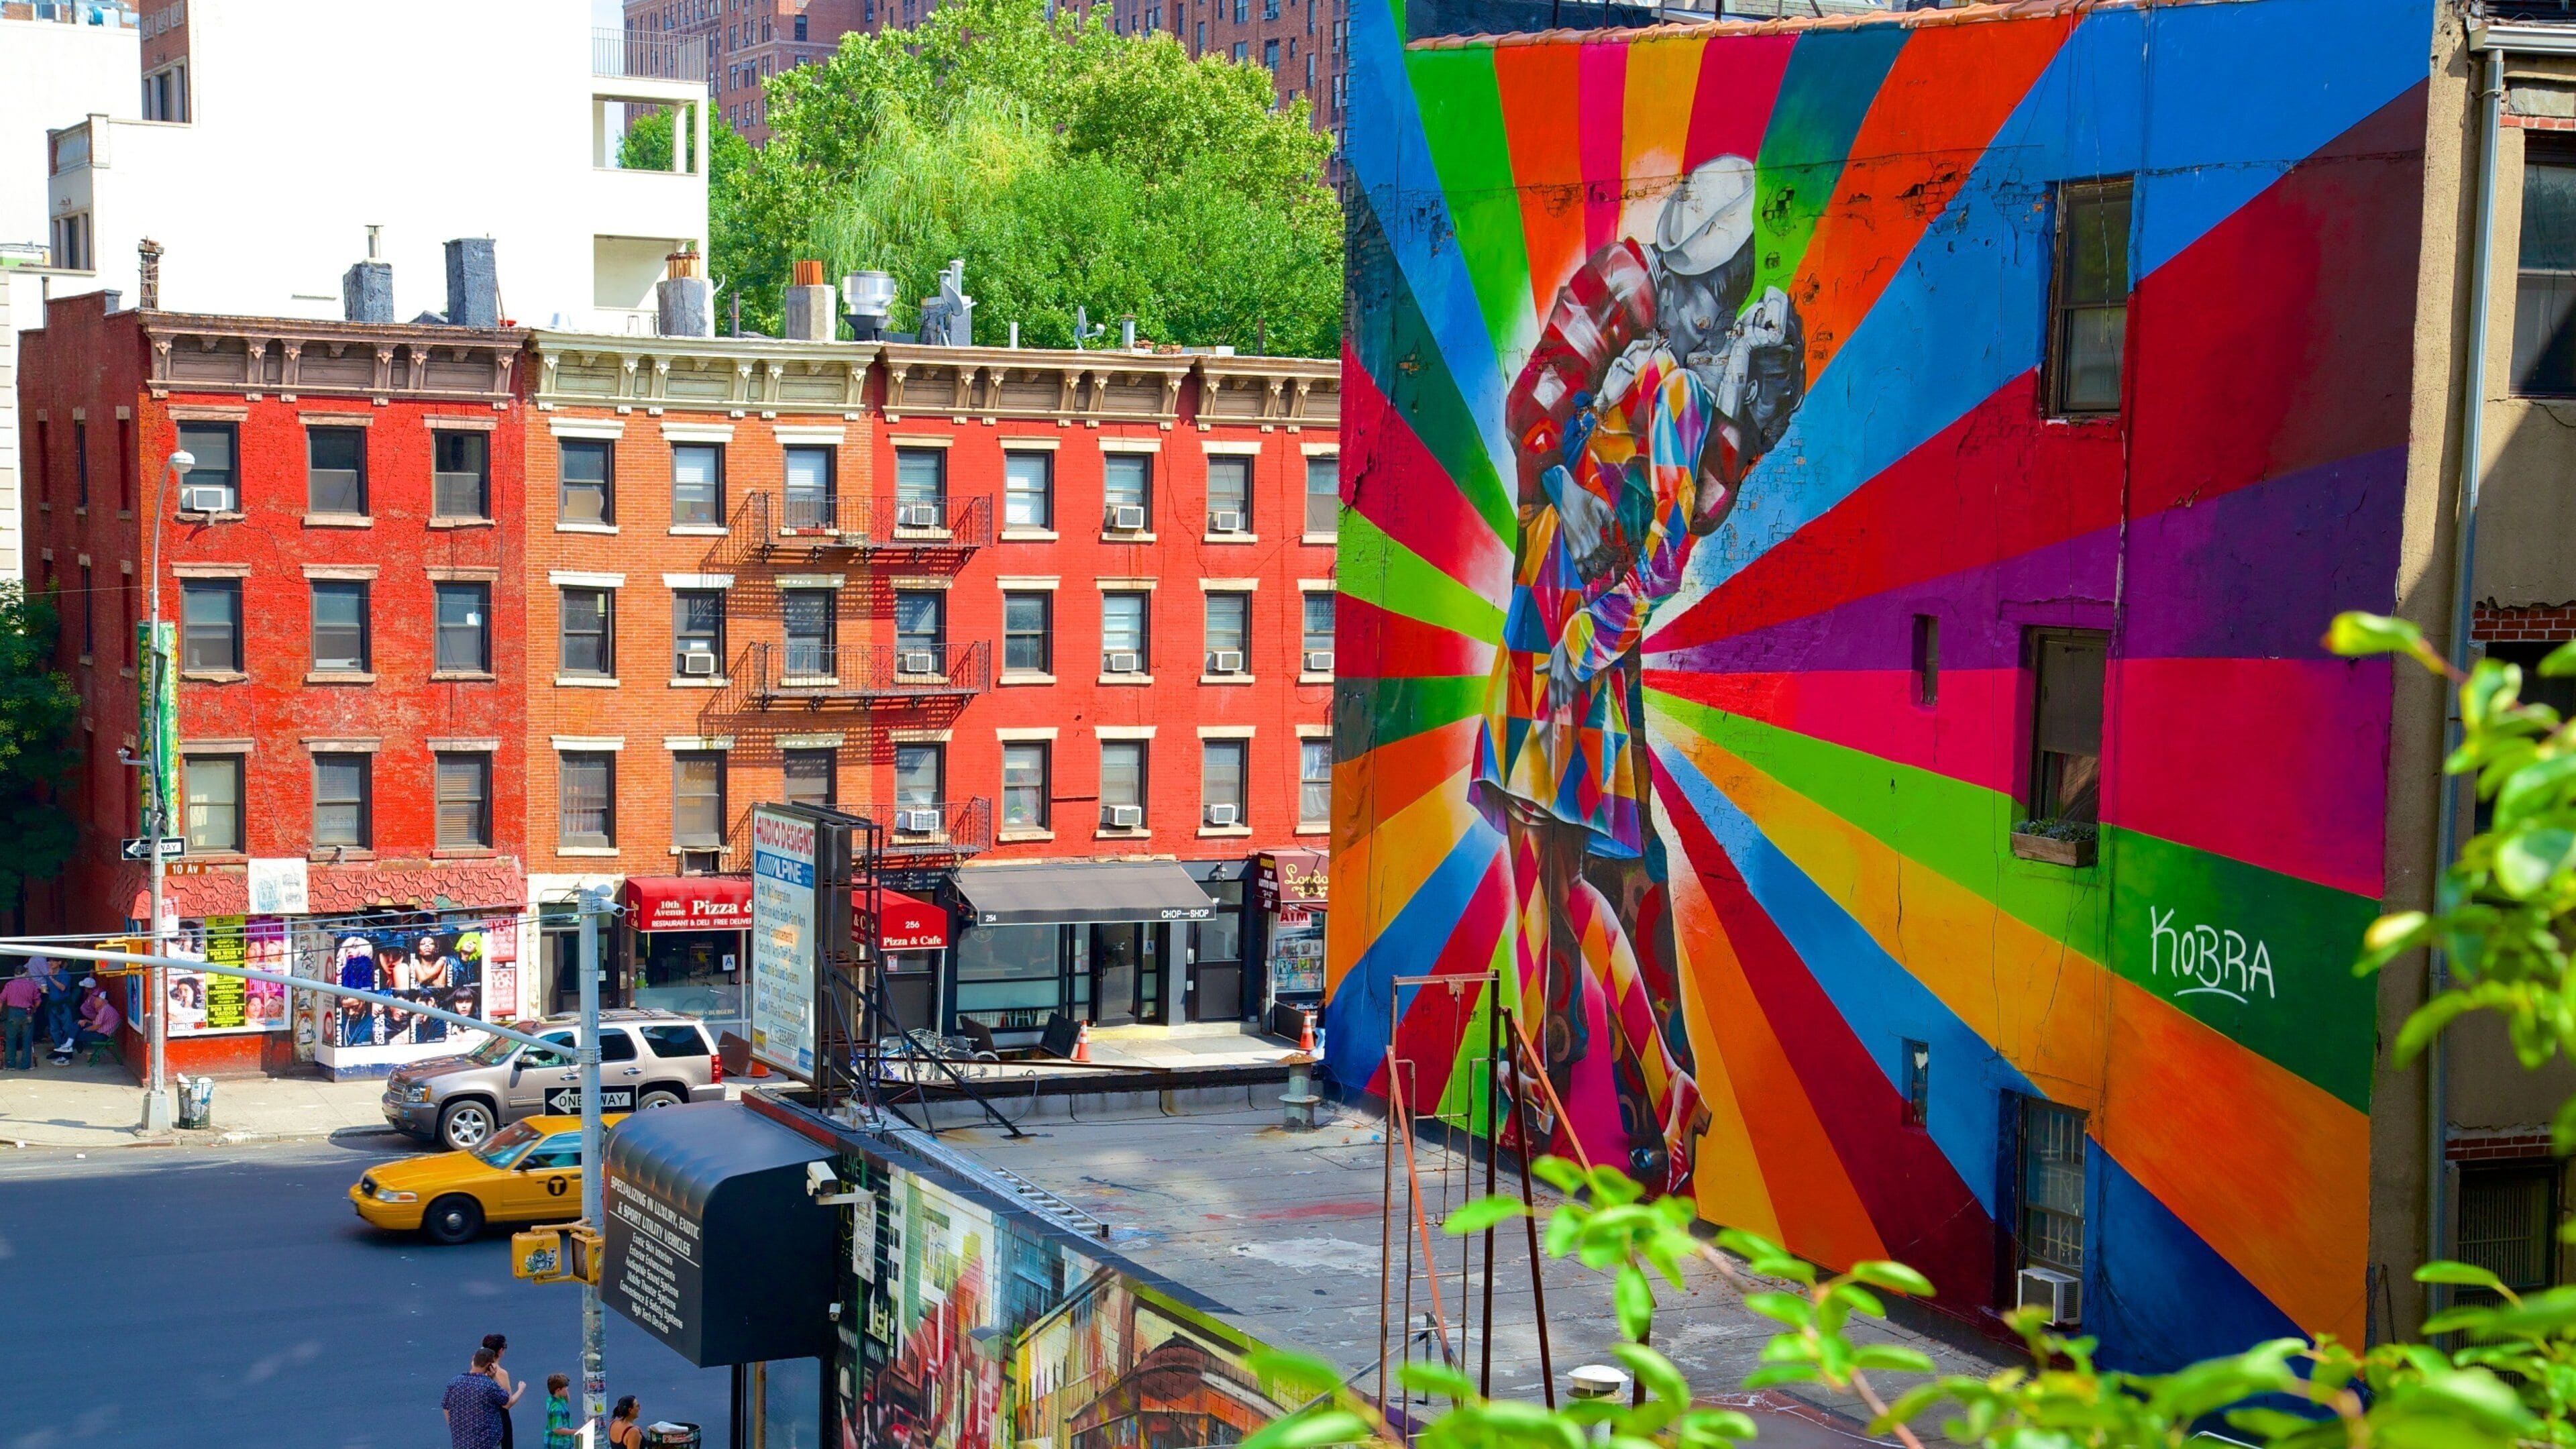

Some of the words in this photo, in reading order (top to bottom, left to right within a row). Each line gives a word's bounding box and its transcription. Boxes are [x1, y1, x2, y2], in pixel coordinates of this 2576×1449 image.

[133, 845, 150, 853] ONE
[172, 865, 183, 875] 10
[187, 865, 199, 874] Av
[661, 900, 680, 909] 10th
[692, 900, 739, 916] Pizza
[743, 900, 752, 913] &
[654, 909, 686, 917] Avenue
[985, 914, 996, 922] 254
[1280, 909, 1308, 922] ATM
[651, 919, 688, 928] RESTAURANT
[696, 918, 710, 926] DELI
[853, 914, 859, 927] &
[905, 921, 920, 929] 256
[883, 937, 908, 947] Pizza
[910, 936, 918, 945] &
[920, 936, 942, 945] Cafe
[1145, 942, 1152, 951] A
[2150, 906, 2275, 998] KOBRA
[725, 957, 733, 966] A
[559, 1095, 582, 1107] ONE
[550, 1179, 564, 1195] T
[610, 1175, 646, 1207] SPECIALIZING
[647, 1196, 654, 1210] IN
[654, 1201, 678, 1230] LUXURY,
[679, 1216, 700, 1240] EXOTIC
[617, 1201, 623, 1214] &
[623, 1205, 642, 1226] SPORT
[642, 1216, 663, 1240] UTILITY
[664, 1228, 691, 1256] VEHICLES
[633, 1232, 645, 1249] Exotic
[645, 1239, 655, 1255] Skin
[655, 1245, 673, 1266] Interiors
[629, 1244, 645, 1262] Exterior
[645, 1254, 676, 1282] Enhancements
[625, 1256, 646, 1277] Audiophile
[647, 1269, 659, 1287] Sound
[659, 1277, 679, 1299] Systems
[627, 1270, 641, 1289] Mobile
[641, 1280, 657, 1298] Theater
[657, 1289, 677, 1311] Systems
[619, 1279, 645, 1303] Convenience
[645, 1296, 649, 1306] &
[649, 1299, 663, 1318] Safety
[663, 1307, 684, 1330] Systems
[631, 1301, 642, 1317] High
[642, 1307, 652, 1323] Tech
[652, 1315, 669, 1335] Devices
